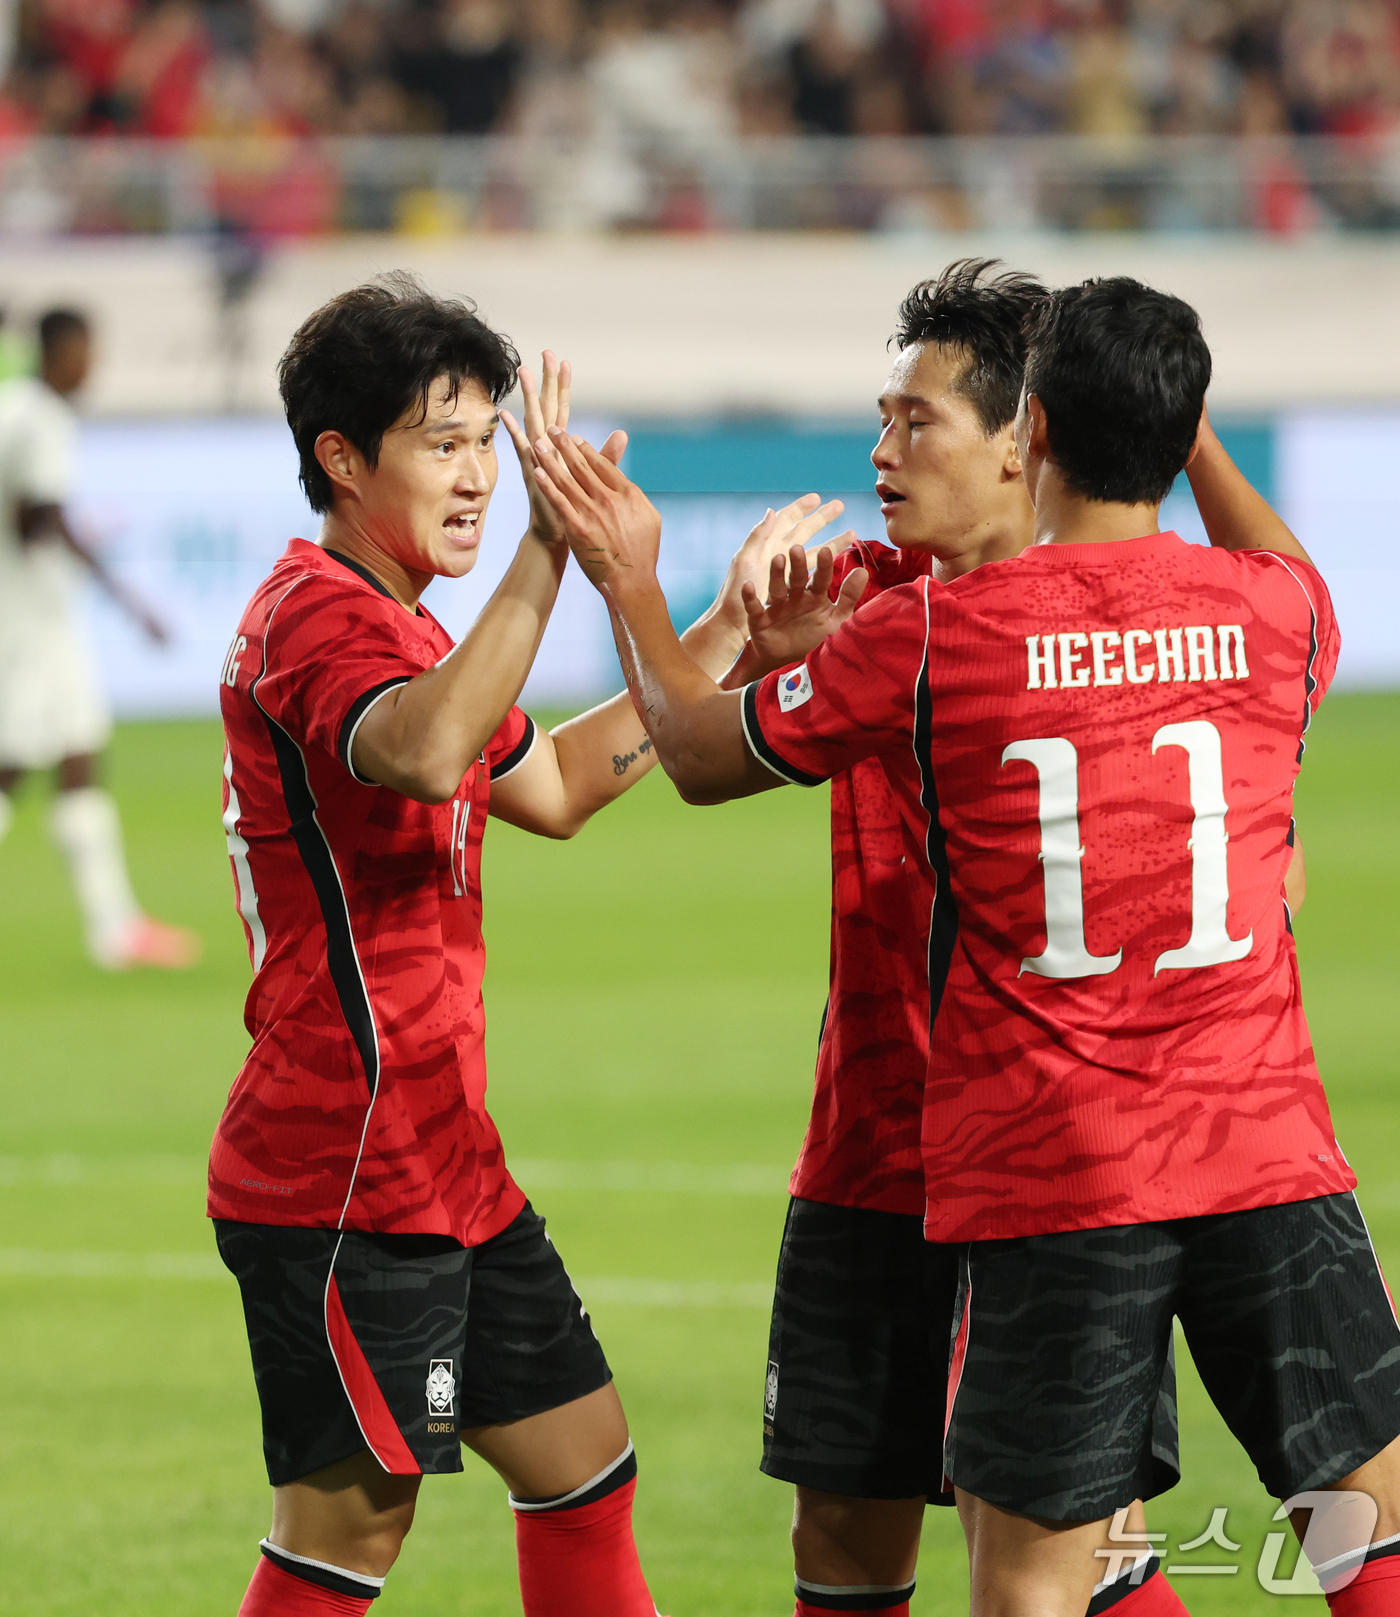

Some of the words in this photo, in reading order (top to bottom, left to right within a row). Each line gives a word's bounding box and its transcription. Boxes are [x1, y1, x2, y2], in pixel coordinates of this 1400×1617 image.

[1025, 624, 1250, 690] HEECHAN
[612, 754, 638, 776] Born
[450, 798, 471, 898] 14
[1001, 719, 1253, 979] 11
[240, 1178, 293, 1195] AERO-FIT
[427, 1422, 455, 1433] KOREA
